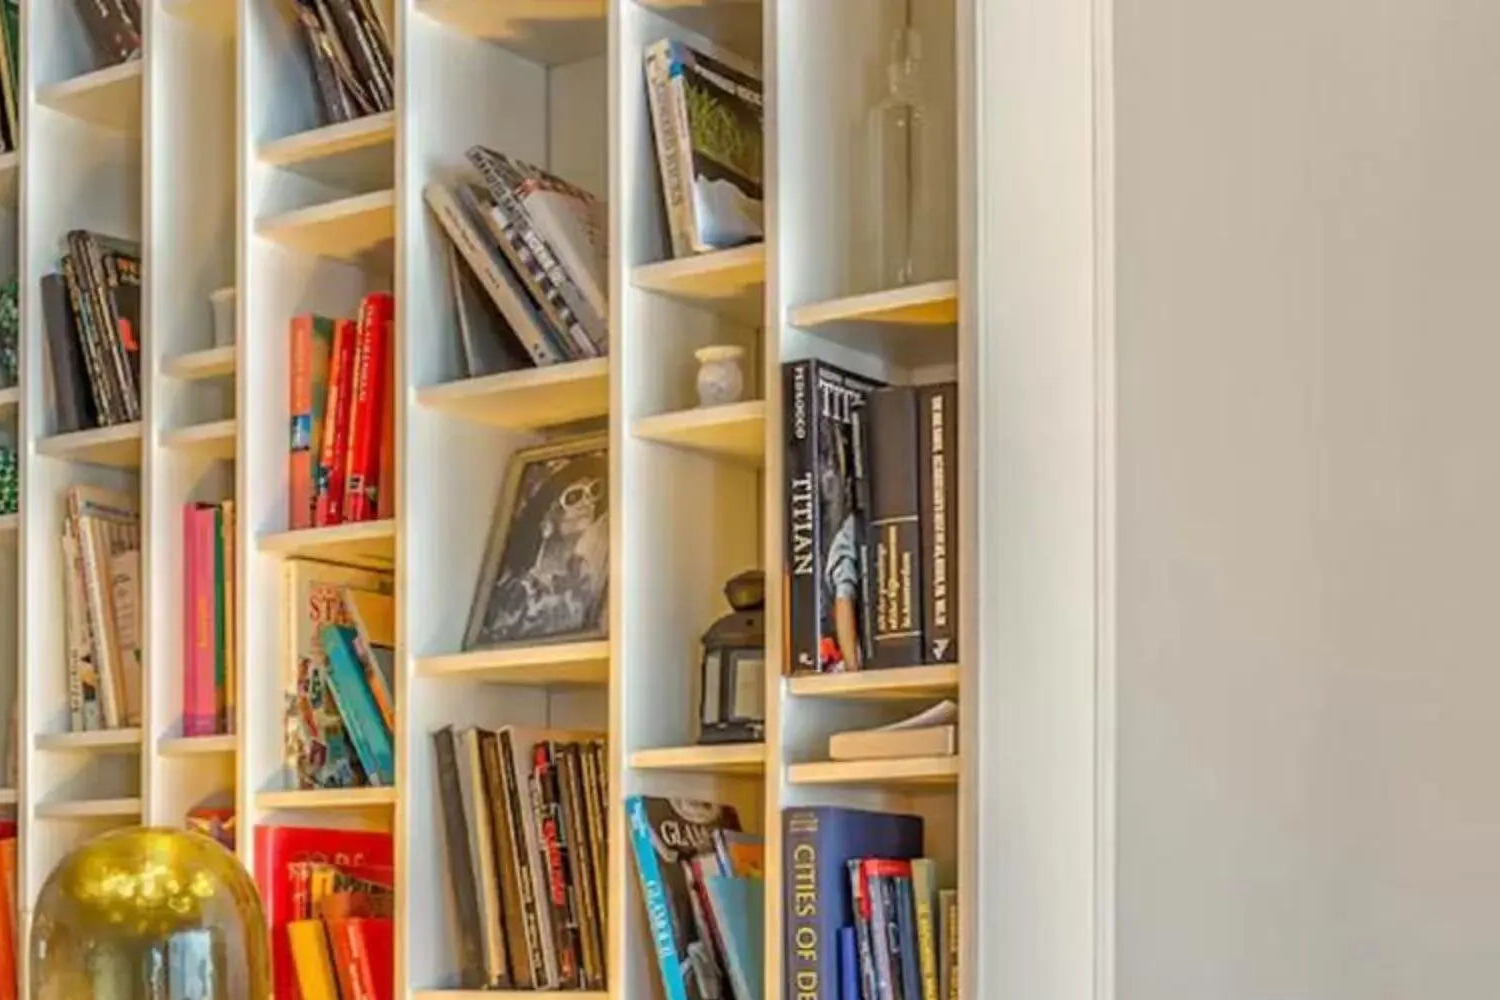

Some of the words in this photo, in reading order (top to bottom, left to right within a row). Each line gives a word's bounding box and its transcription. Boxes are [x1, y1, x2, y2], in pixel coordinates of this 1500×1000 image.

[792, 472, 813, 576] TITIAN
[794, 844, 817, 918] CITIES
[796, 926, 817, 962] OF
